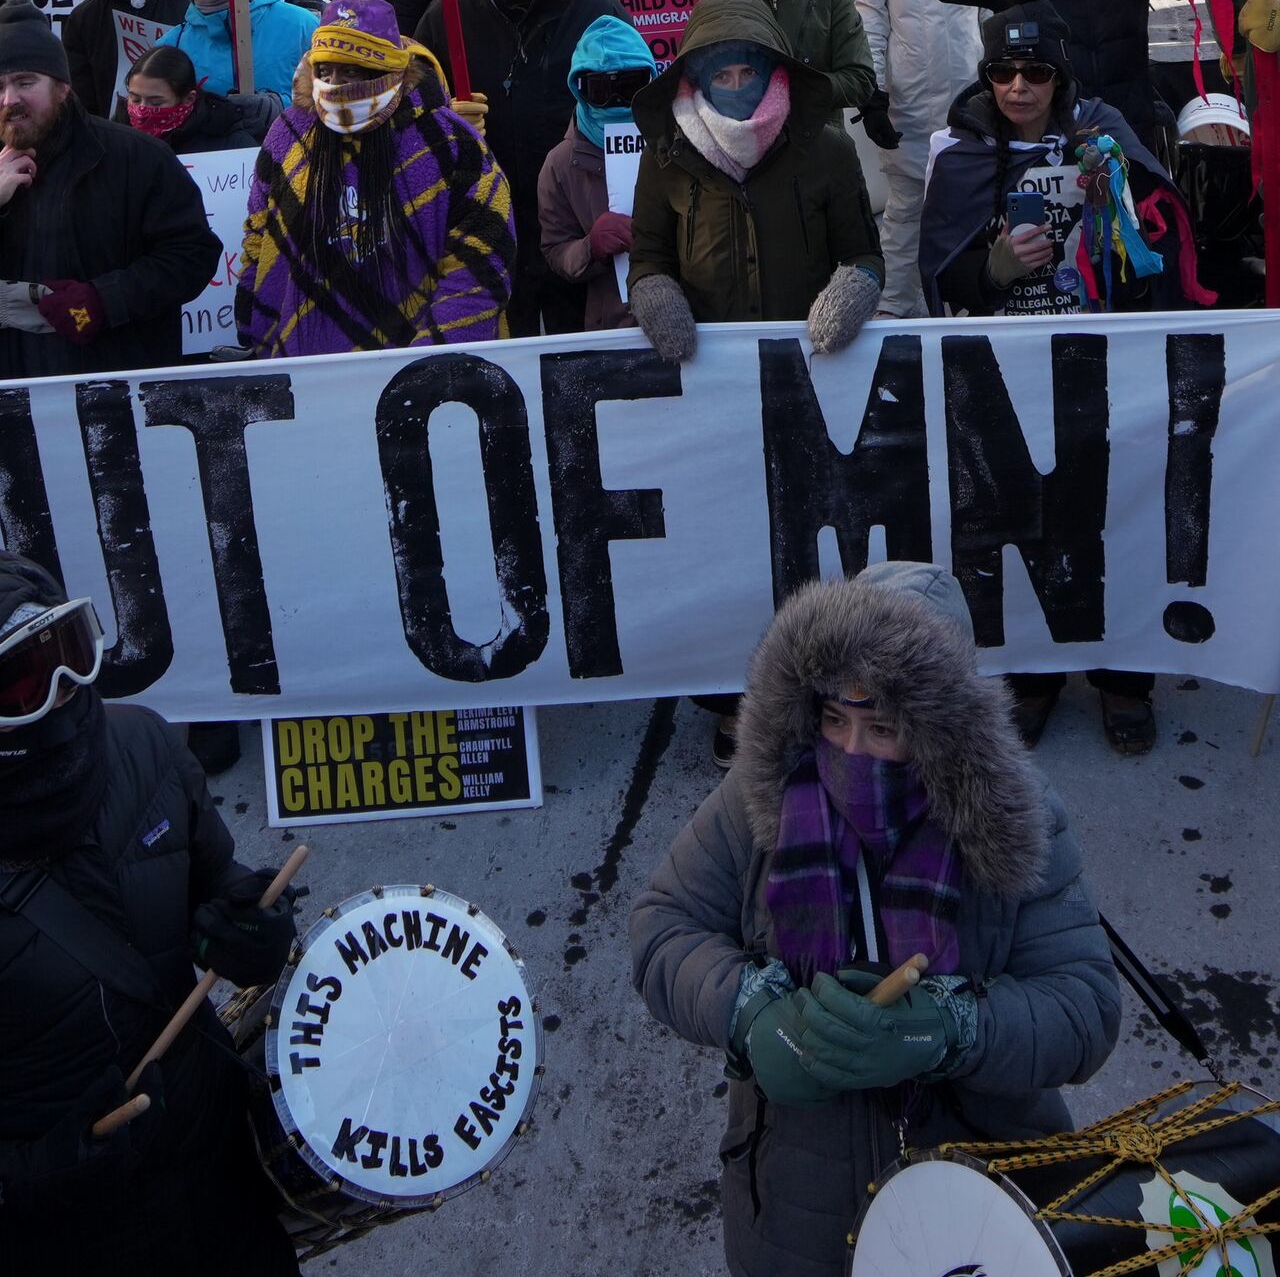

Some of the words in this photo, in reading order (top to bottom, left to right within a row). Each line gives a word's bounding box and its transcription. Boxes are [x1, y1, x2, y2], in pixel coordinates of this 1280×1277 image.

[1020, 176, 1064, 195] OUT
[1024, 284, 1048, 296] ONE
[1016, 298, 1053, 308] ILLEGAL
[1055, 295, 1072, 305] ON
[374, 347, 685, 683] OF
[28, 612, 57, 632] SCOTT
[457, 716, 516, 732] ARMSTRONG
[278, 715, 375, 766] DROP
[388, 710, 457, 757] THE
[460, 738, 512, 752] CHAUNTYLL
[461, 752, 489, 764] ALLEN
[281, 755, 460, 812] CHARGES
[462, 772, 504, 786] WILLIAM
[463, 785, 491, 799] KELLY
[290, 972, 343, 1076] THIS
[334, 909, 489, 982] MACHINE
[331, 1117, 446, 1178] KILLS
[454, 995, 524, 1152] FASCISTS
